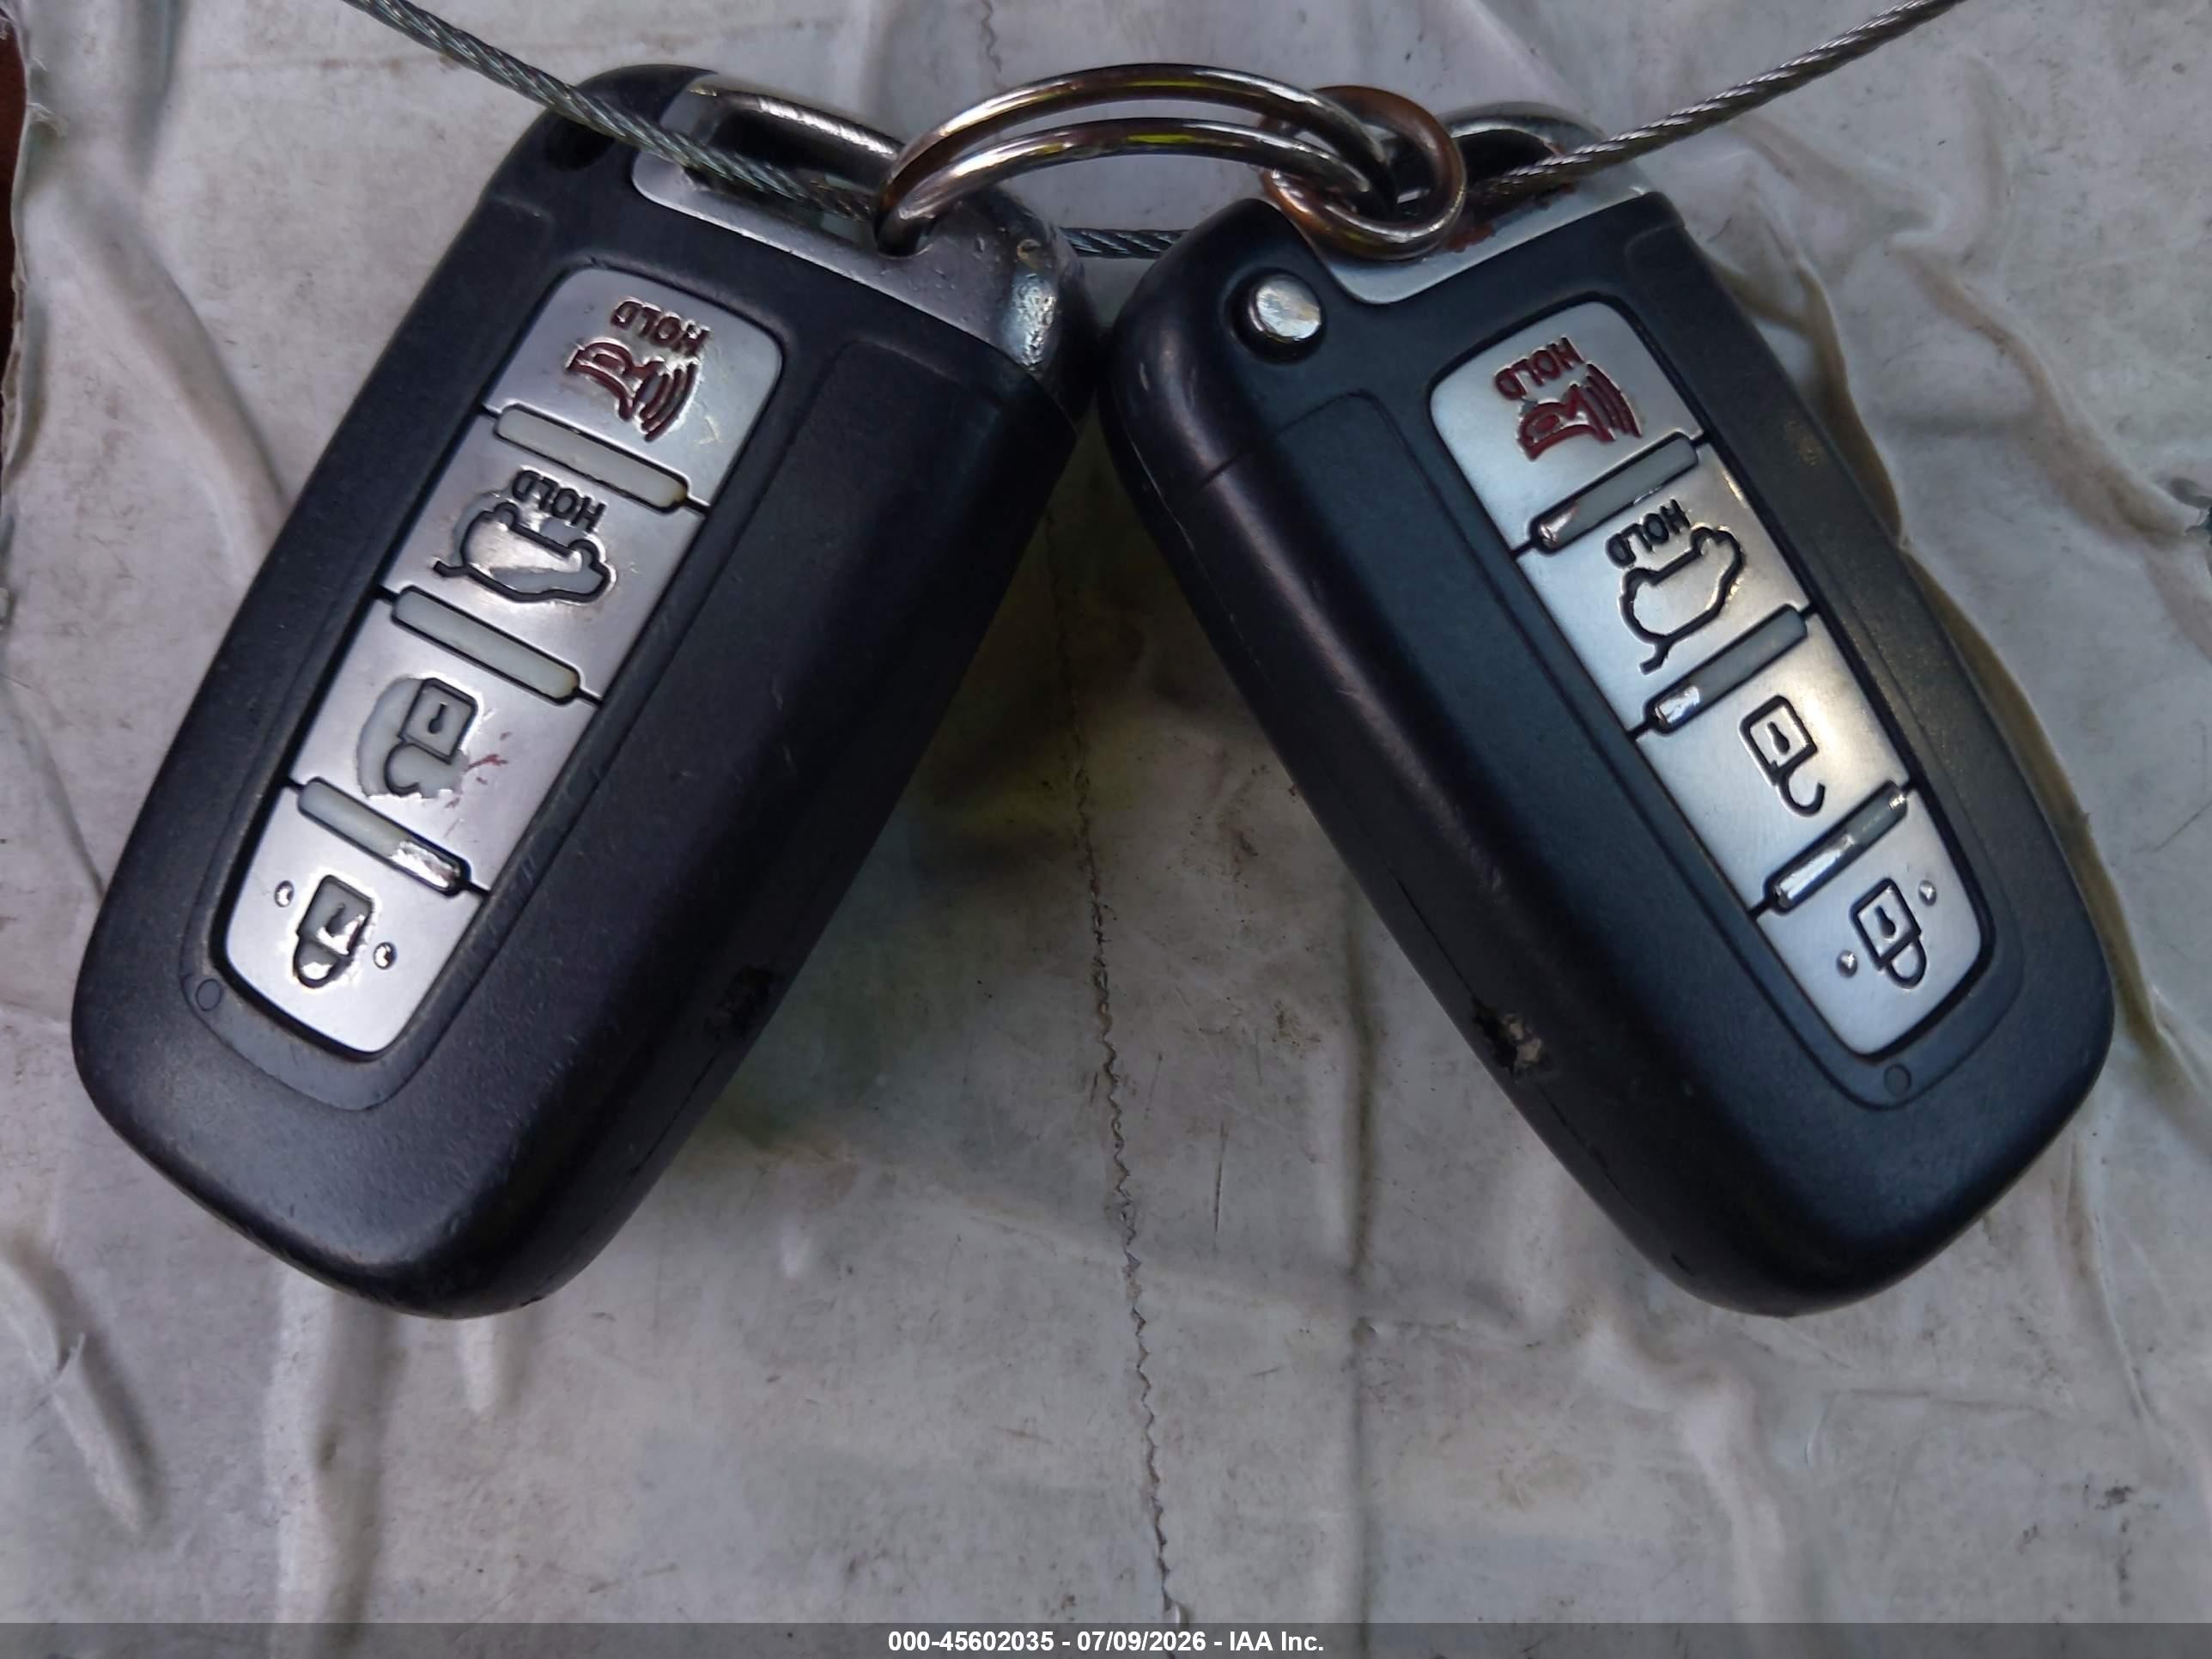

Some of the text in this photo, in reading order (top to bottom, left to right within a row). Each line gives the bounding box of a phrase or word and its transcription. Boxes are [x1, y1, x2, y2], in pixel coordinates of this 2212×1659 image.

[611, 298, 711, 356] HOLD
[1493, 336, 1584, 401] HOLD
[512, 467, 606, 532] HOLD
[1604, 497, 1691, 570] HOLD
